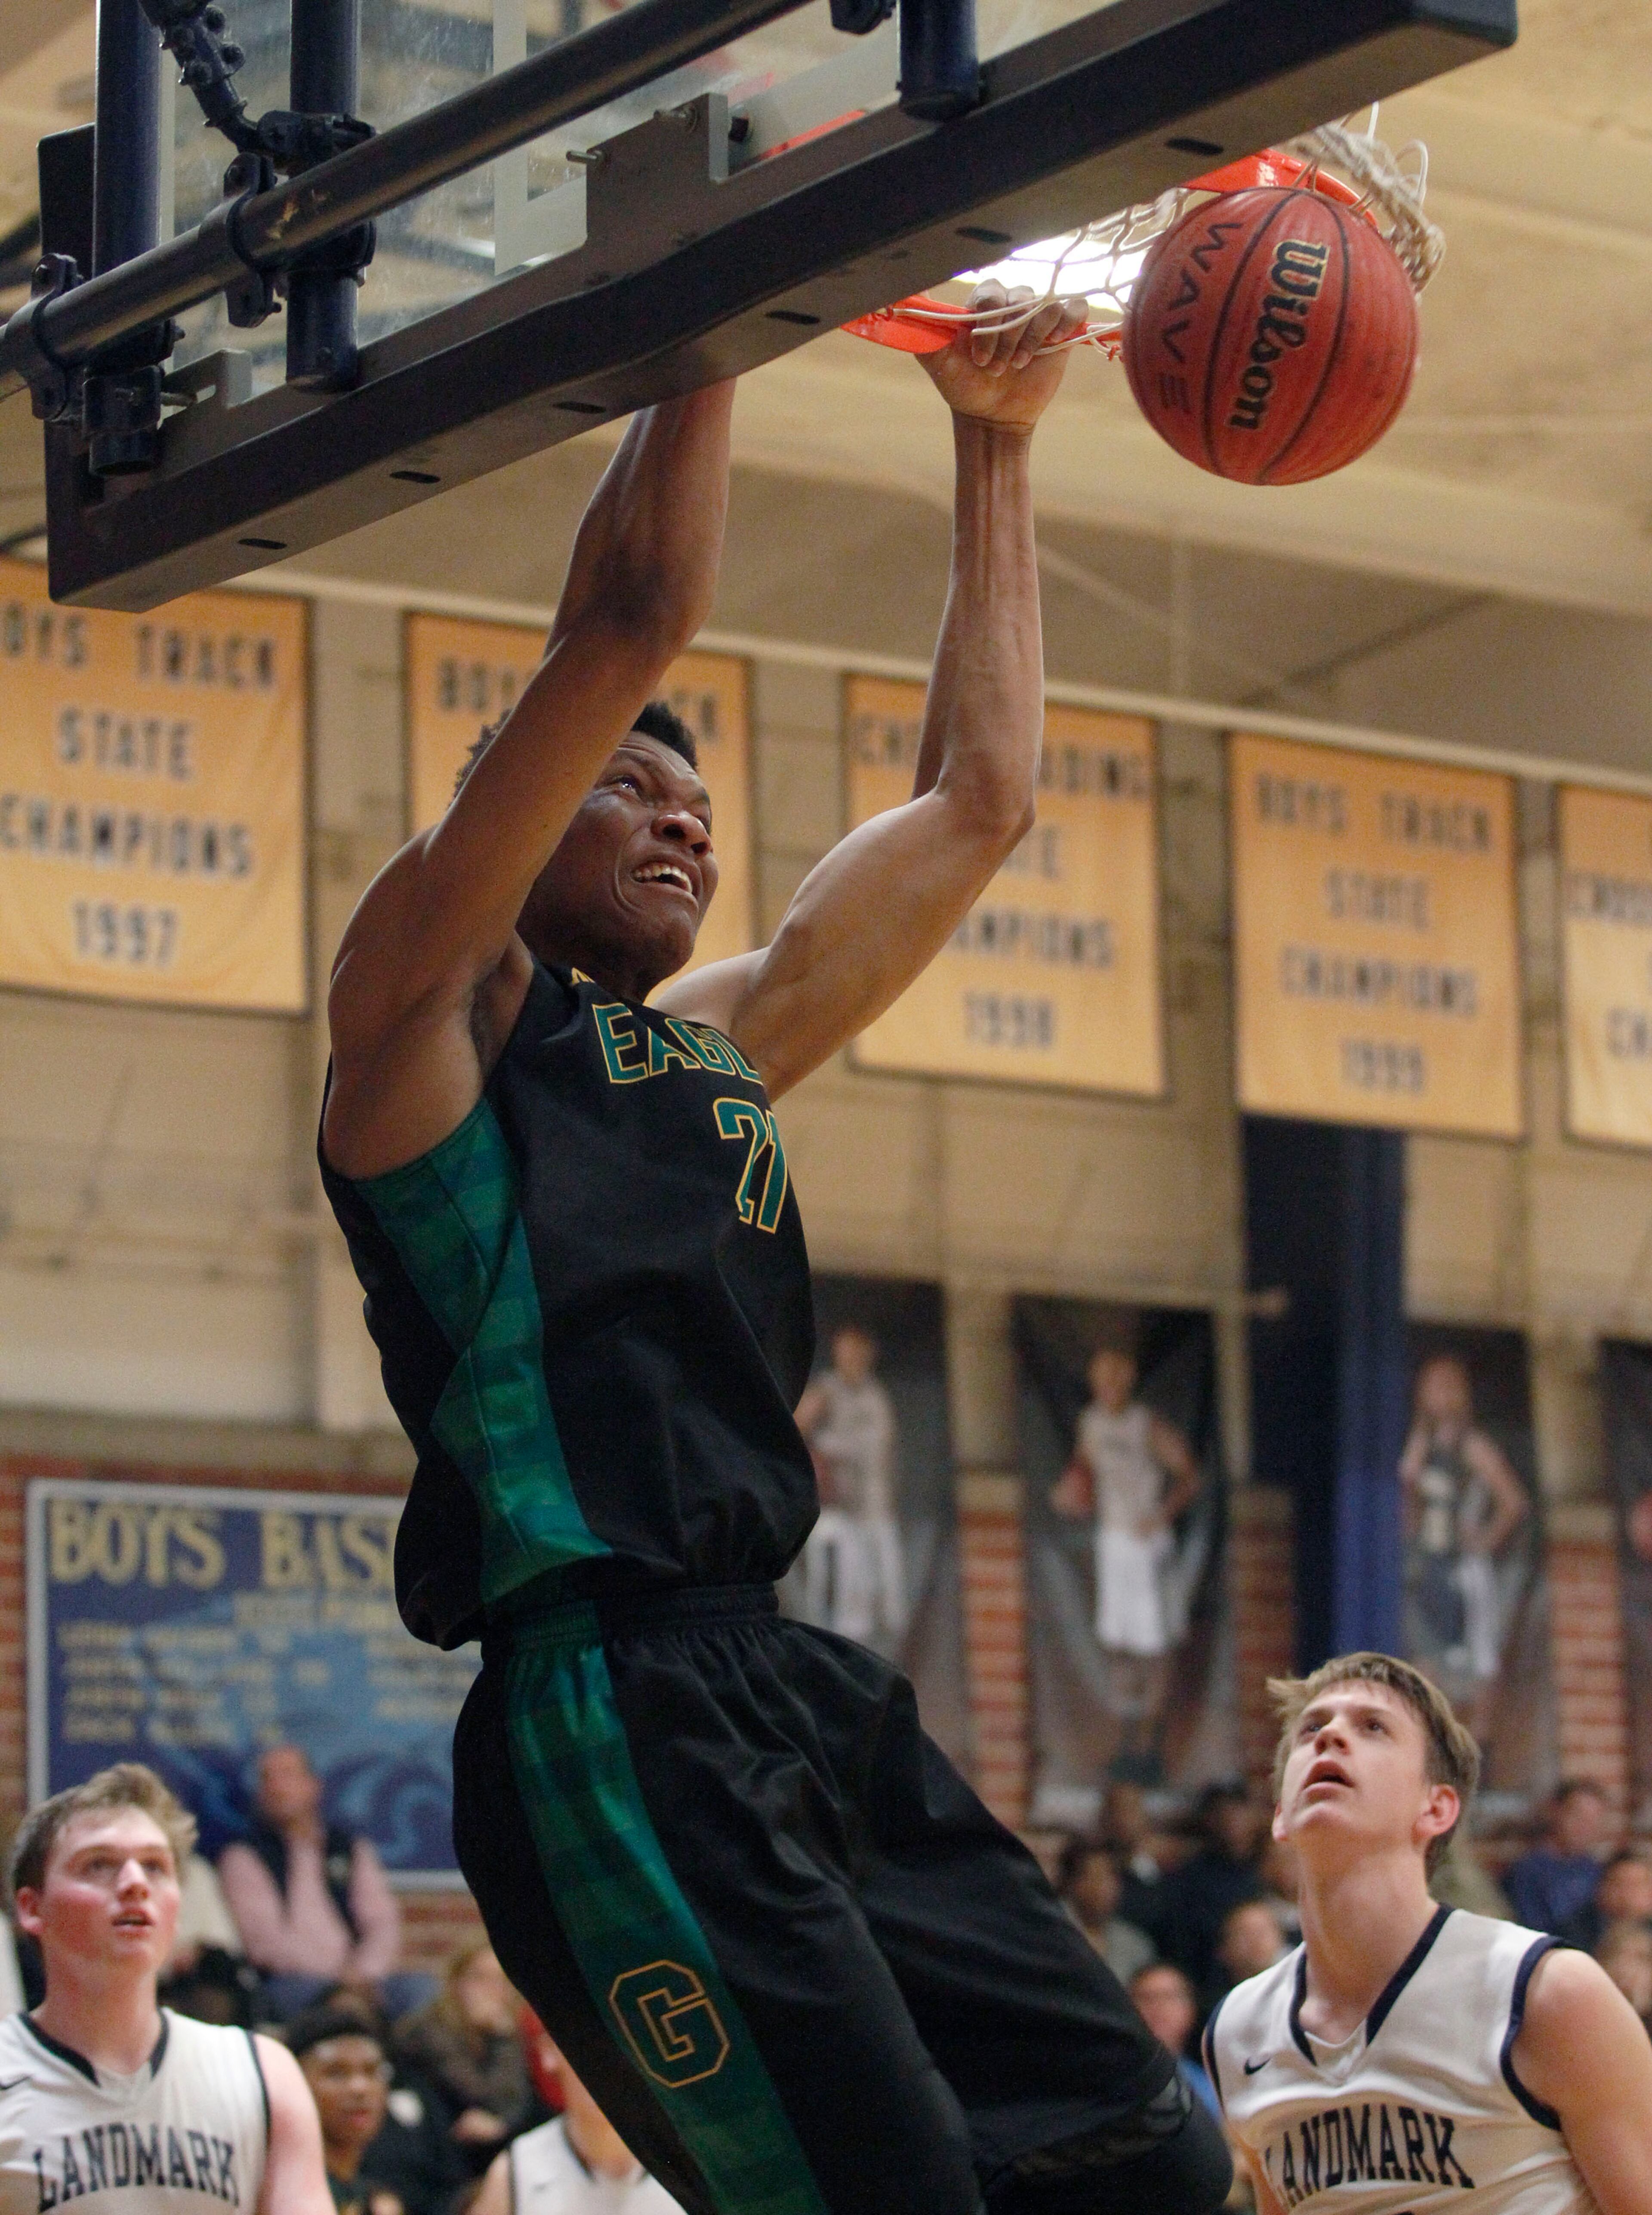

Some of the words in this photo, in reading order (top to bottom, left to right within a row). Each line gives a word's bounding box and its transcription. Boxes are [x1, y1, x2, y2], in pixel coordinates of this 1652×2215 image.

[1160, 221, 1244, 413] WAVE
[1230, 238, 1331, 430] Wilson
[1, 602, 87, 668] OYS
[59, 706, 192, 781] STATE
[592, 1002, 764, 1086] EAGL
[712, 1097, 788, 1234] 21
[48, 1500, 226, 1591] BOYS
[607, 1959, 730, 2088] G
[32, 2121, 240, 2214] LANDMARK
[1265, 2103, 1476, 2207] ANDMARK
